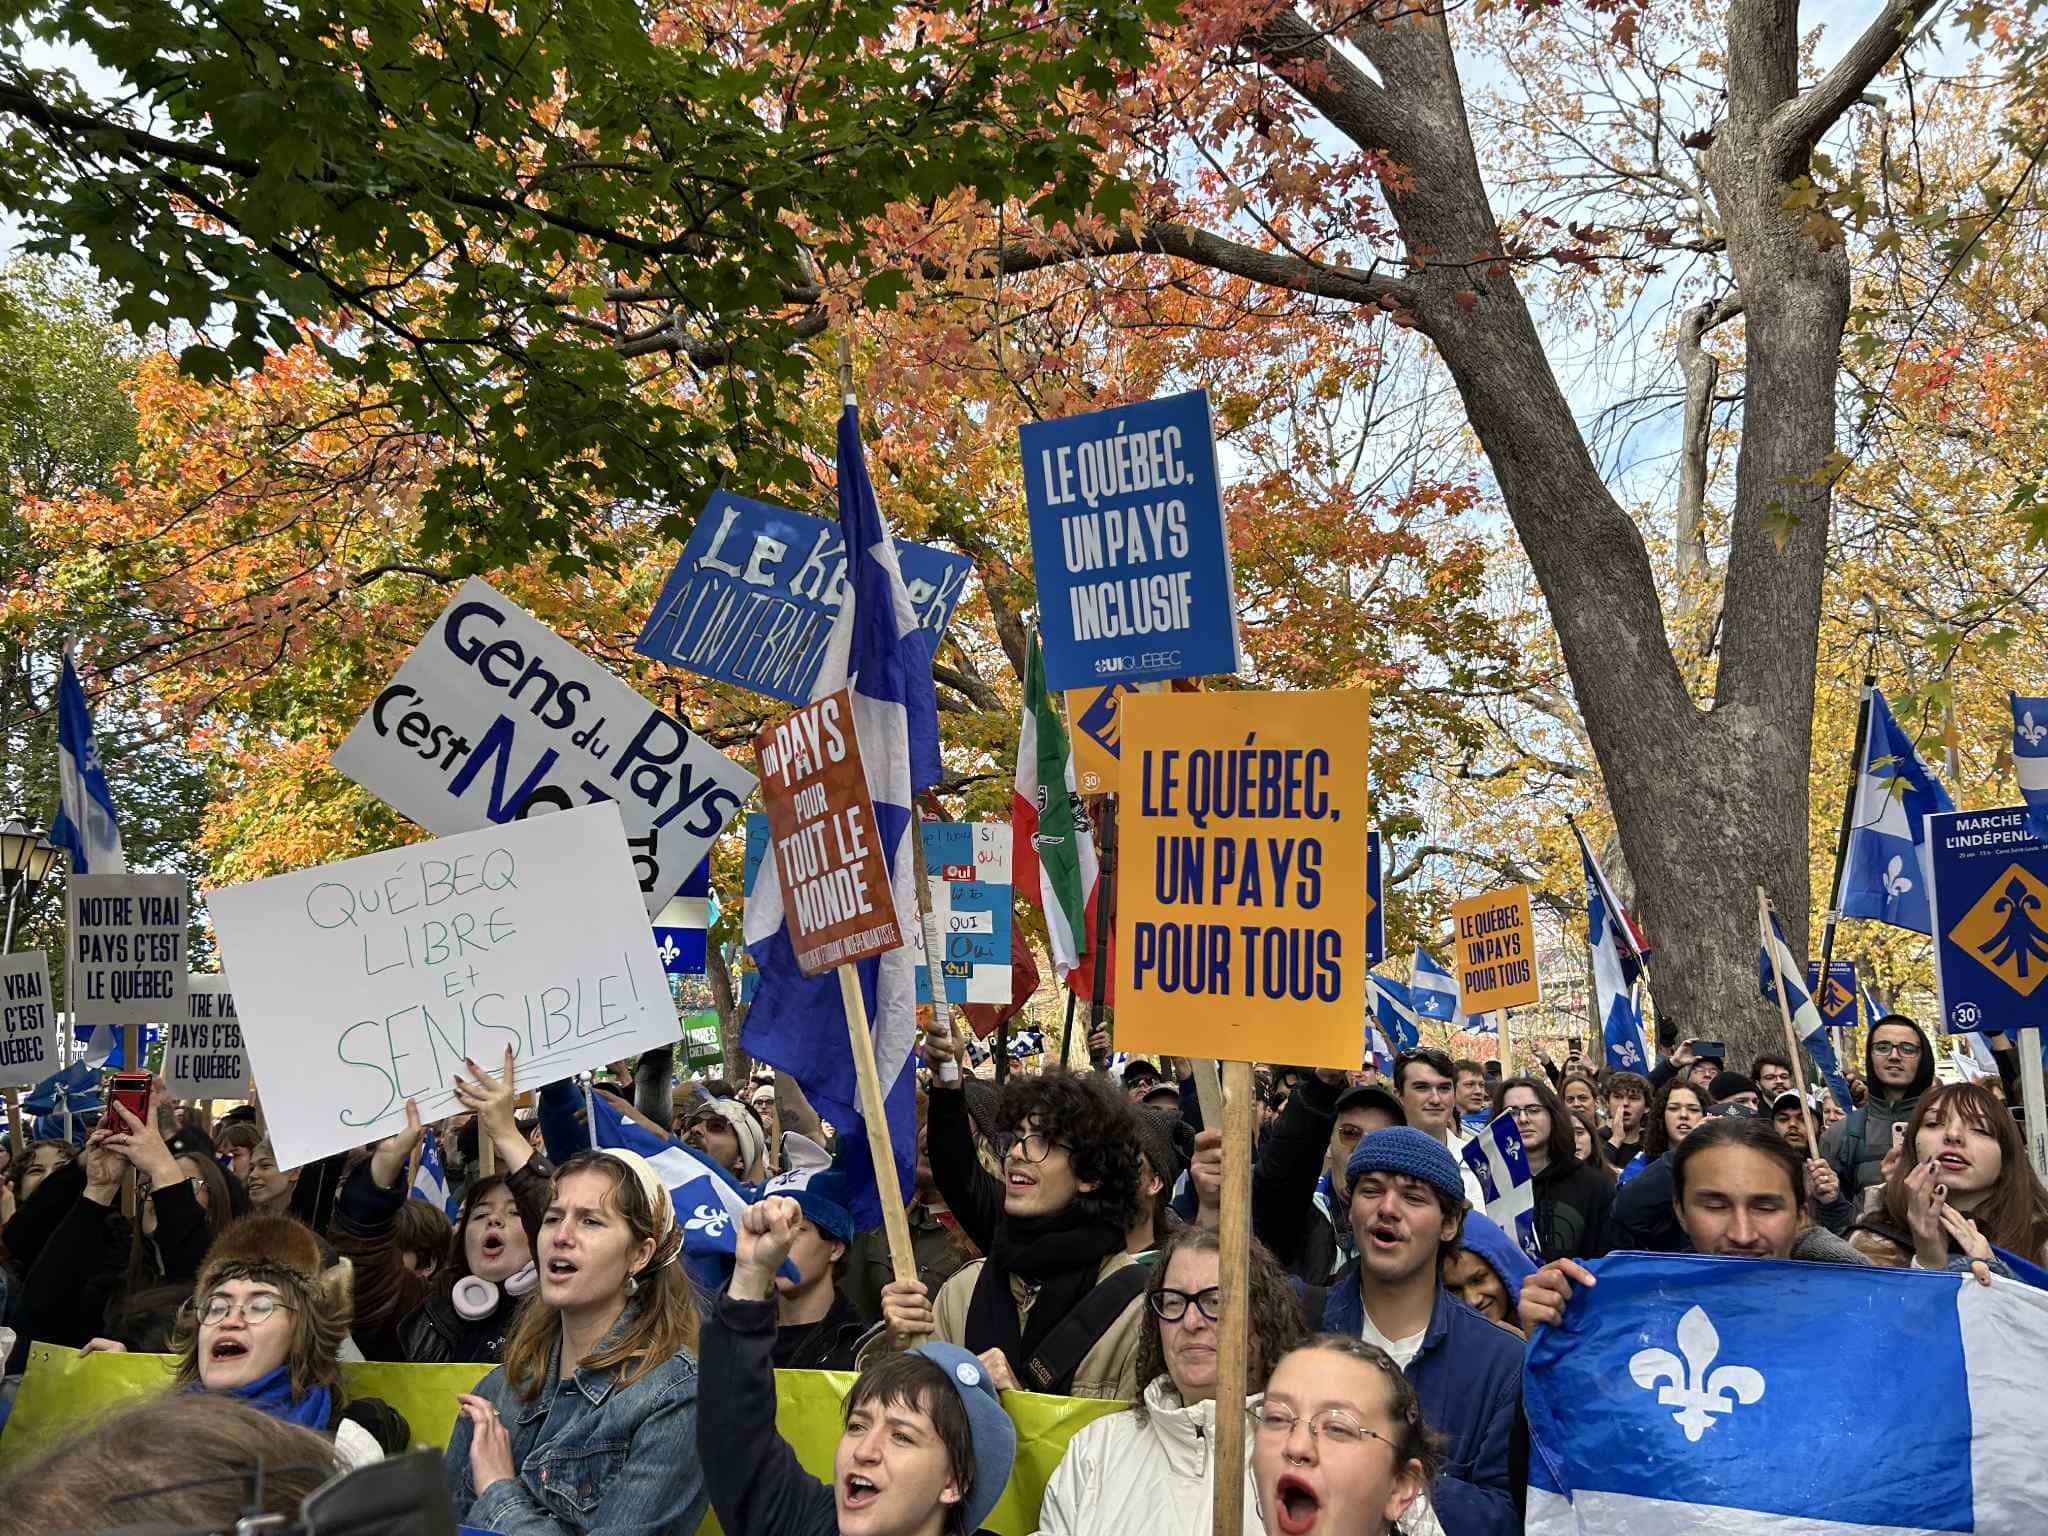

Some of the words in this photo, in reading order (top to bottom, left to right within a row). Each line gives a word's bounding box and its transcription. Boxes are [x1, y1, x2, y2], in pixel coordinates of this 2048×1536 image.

[1042, 447, 1076, 506] LE
[1077, 420, 1195, 508] QUÉBEC,
[1061, 513, 1104, 573] UN
[1104, 499, 1189, 567] PAYS
[1070, 572, 1192, 641] INCLUSIF
[373, 685, 471, 771] C'est
[444, 602, 590, 729] Gens
[572, 718, 611, 760] du
[611, 709, 740, 838] Pays
[762, 743, 779, 777] UN
[776, 699, 845, 787] PAYS
[1084, 776, 1097, 787] 30
[1142, 750, 1179, 817] LE
[1187, 732, 1340, 829] QUÉBEC,
[794, 782, 828, 823] POUR
[1956, 814, 2022, 831] MARCHE
[778, 820, 830, 887] TOUT
[833, 806, 869, 864] LE
[1946, 830, 2039, 848] L'INDÉPEND
[307, 848, 519, 928] QUÉBEQ
[1156, 836, 1205, 905] UN
[1212, 837, 1322, 909] PAYS
[80, 897, 132, 926] NOTRE
[139, 896, 179, 926] VRAI
[793, 861, 872, 936] MONDE
[364, 907, 517, 976] LIBRE
[1461, 916, 1473, 939] LE
[80, 934, 128, 962] PAYS
[1133, 922, 1231, 995] POUR
[1240, 926, 1341, 1003] TOUS
[1468, 942, 1485, 965] UN
[1487, 933, 1521, 961] PAYS
[4, 971, 42, 1000] VRAI
[87, 971, 104, 999] LE
[112, 963, 173, 1003] QUÉBEC
[1465, 967, 1497, 994] POUR
[1498, 959, 1530, 987] TOUS
[188, 994, 212, 1017] TRE
[0, 1033, 44, 1066] UÉBEC
[172, 1024, 208, 1048] PAYS
[176, 1055, 189, 1078] LE
[193, 1048, 241, 1083] QUÉBEC
